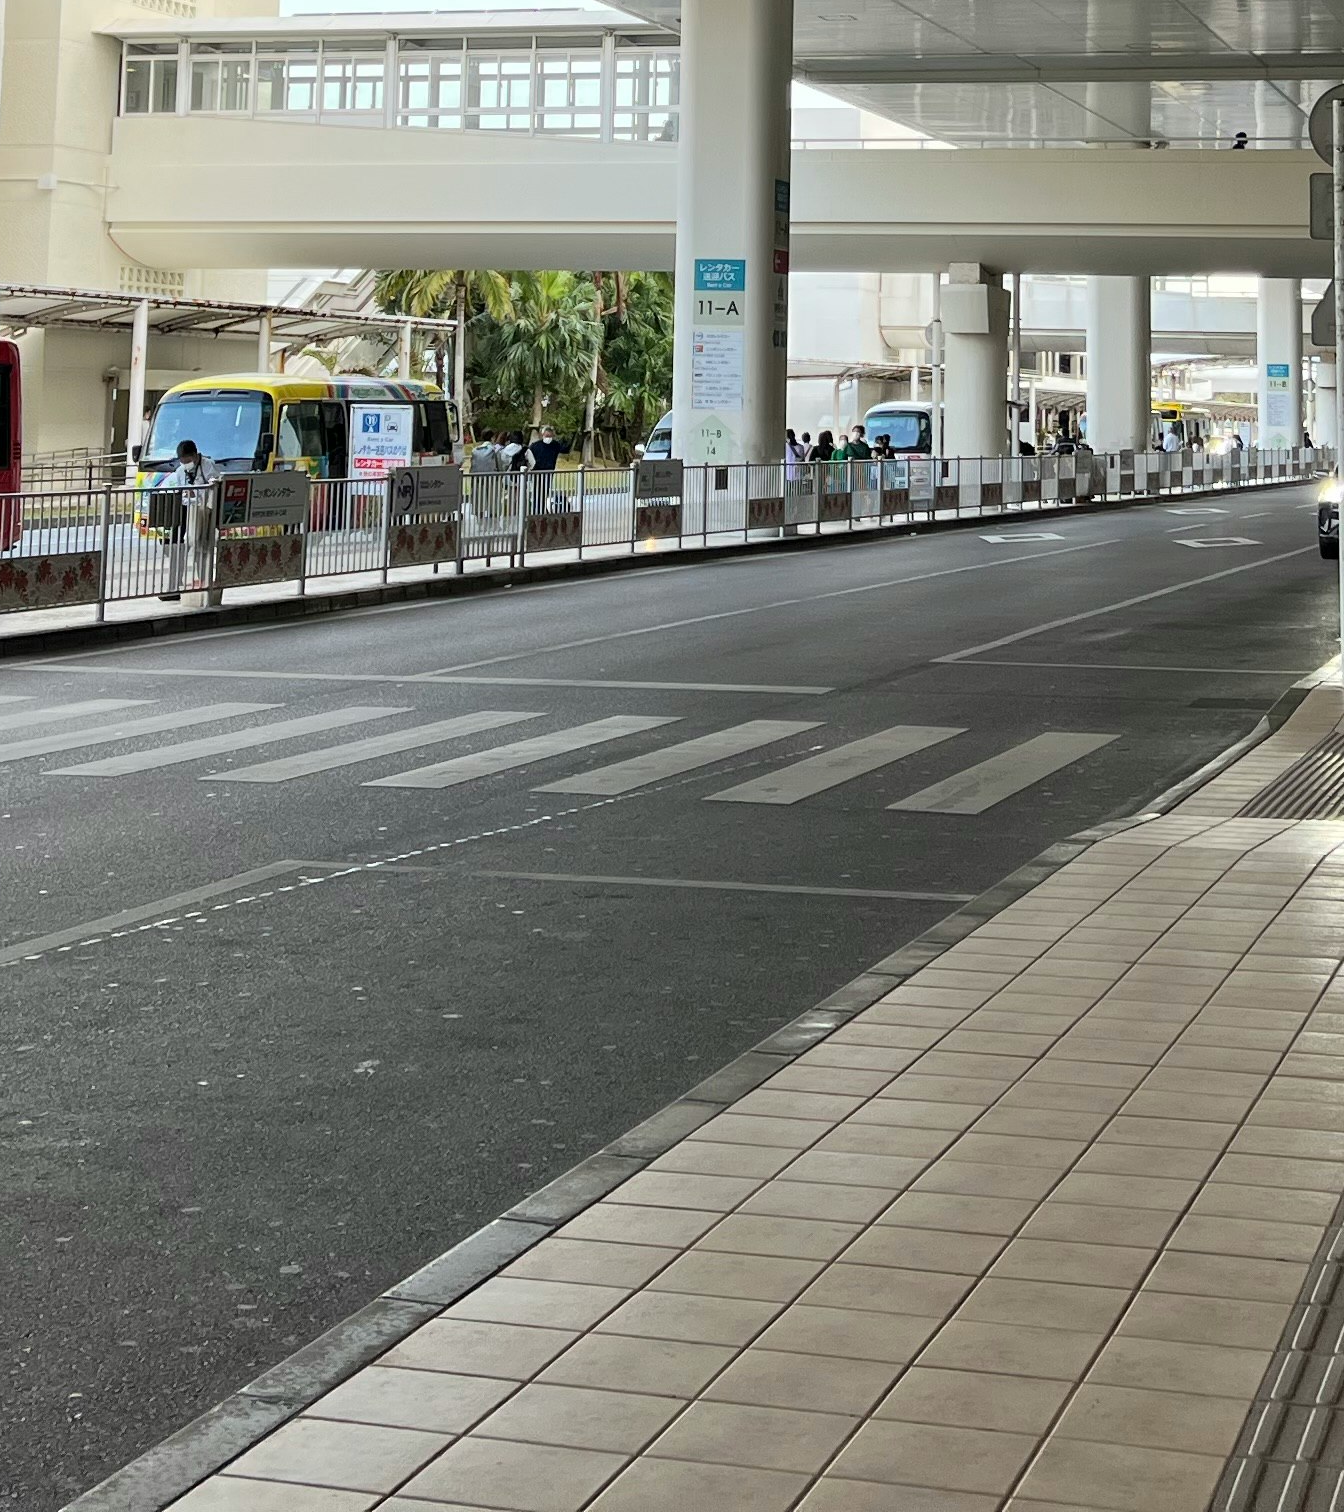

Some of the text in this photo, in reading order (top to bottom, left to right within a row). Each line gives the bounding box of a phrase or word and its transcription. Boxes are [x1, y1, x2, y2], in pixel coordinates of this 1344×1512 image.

[699, 263, 740, 272] レンタカー
[698, 300, 739, 316] 11-A
